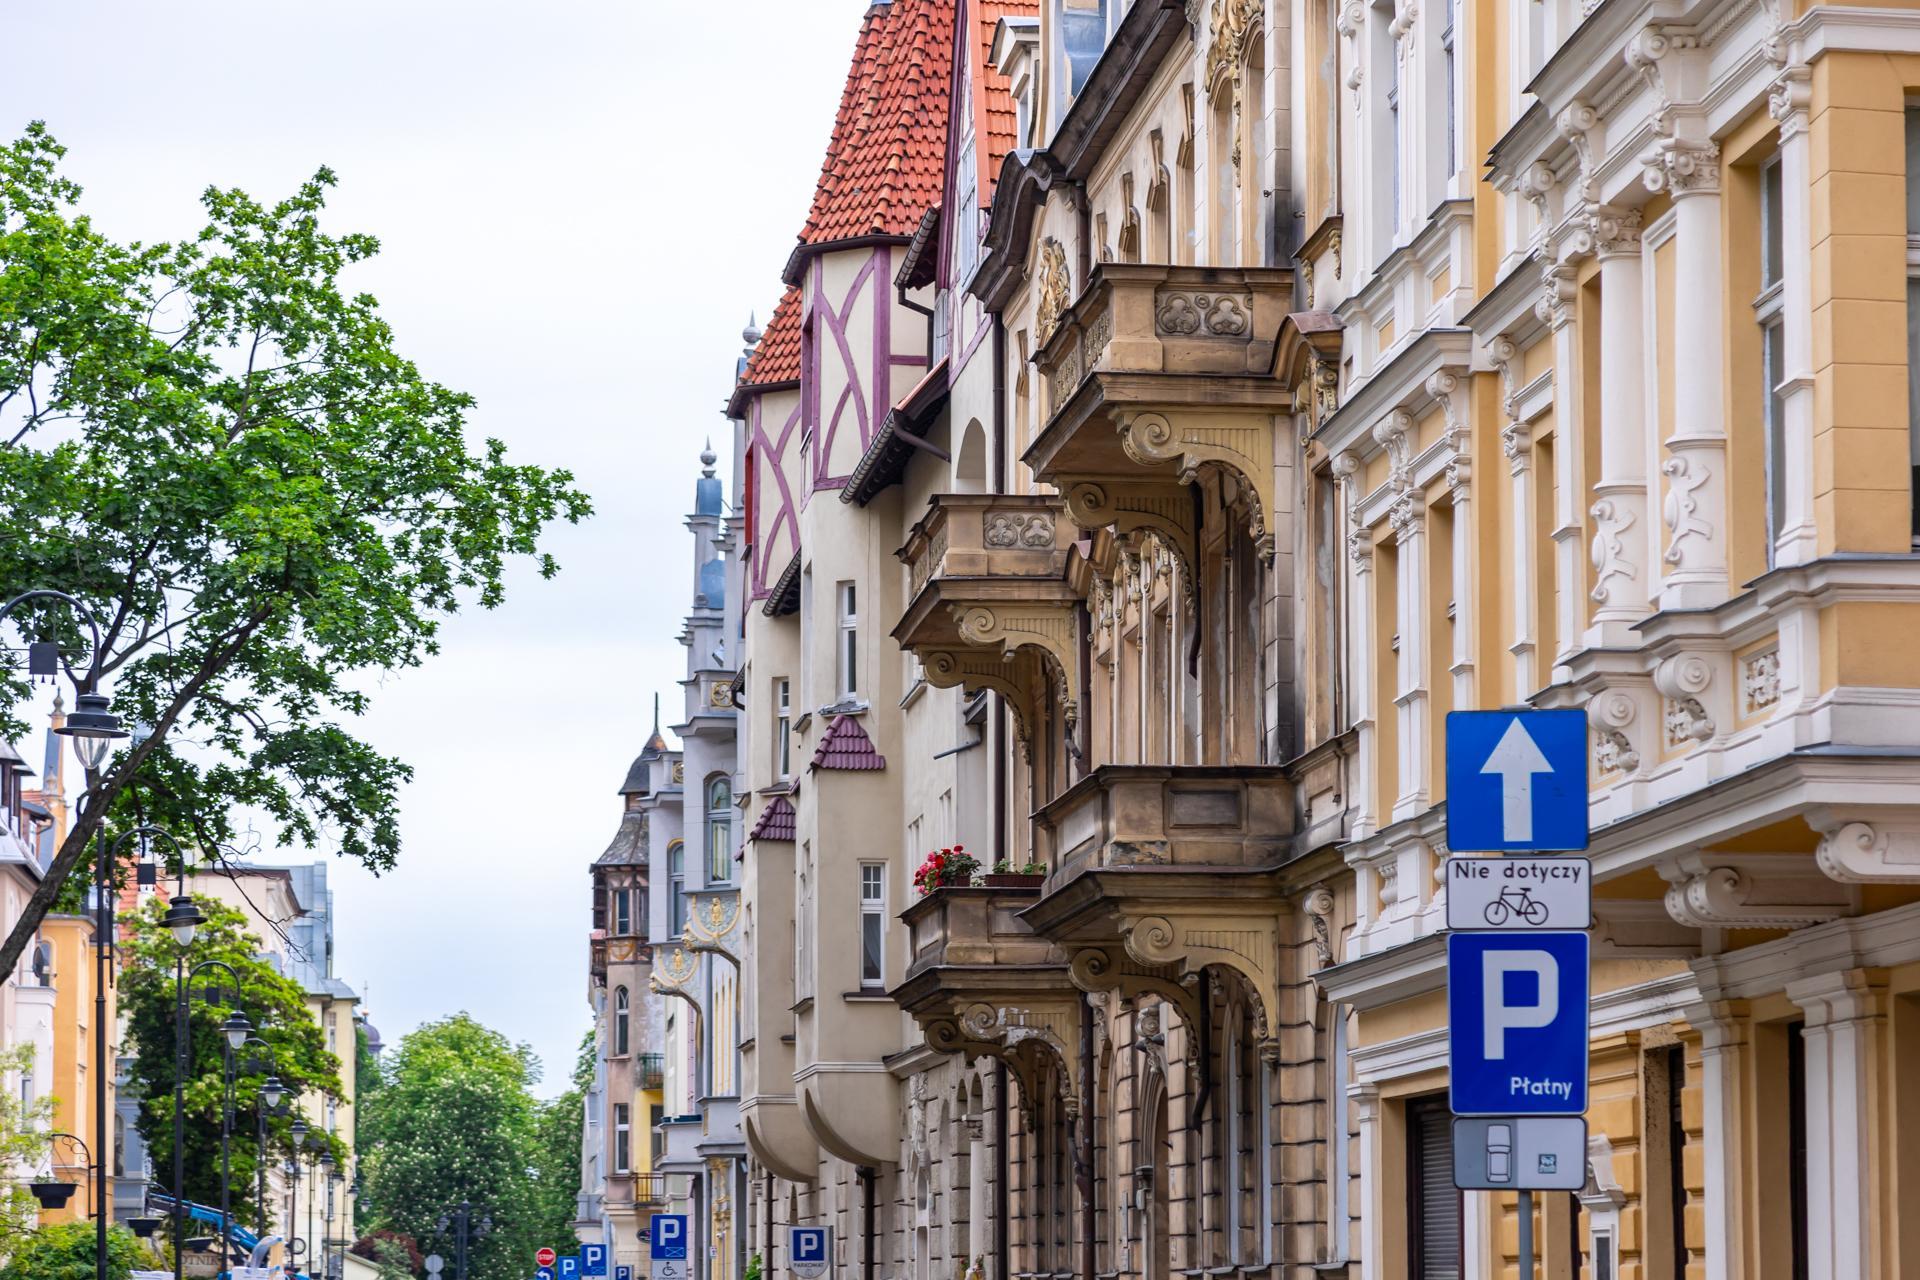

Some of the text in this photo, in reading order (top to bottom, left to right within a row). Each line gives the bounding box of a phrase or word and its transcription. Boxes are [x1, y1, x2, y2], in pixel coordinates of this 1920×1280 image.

[1455, 861, 1581, 884] Nie dotyczy
[1482, 949, 1559, 1060] P
[1510, 1076, 1573, 1100] Płatny
[659, 1218, 680, 1247] P
[587, 1246, 602, 1267] P
[800, 1232, 818, 1258] P
[563, 1259, 575, 1275] P
[618, 1268, 628, 1279] P
